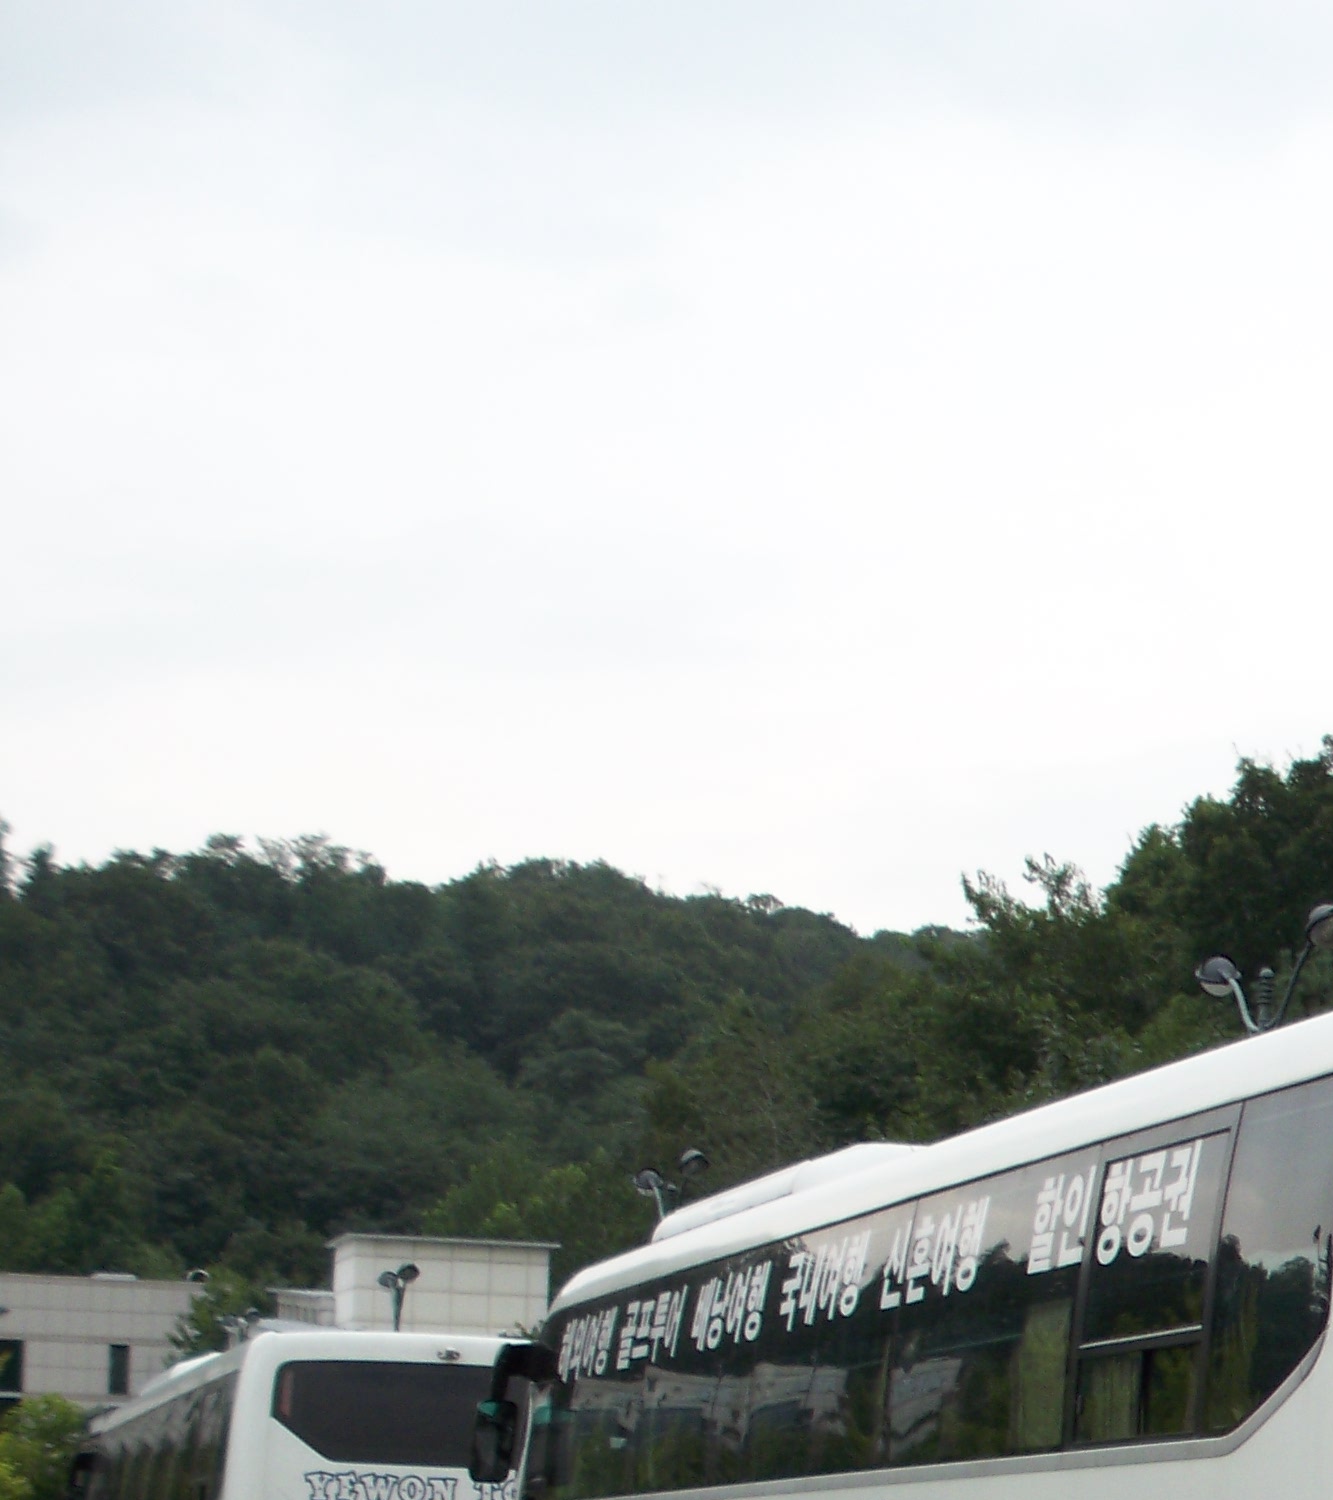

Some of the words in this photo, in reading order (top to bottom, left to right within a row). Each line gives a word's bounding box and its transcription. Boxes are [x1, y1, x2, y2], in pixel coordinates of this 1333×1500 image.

[616, 1284, 689, 1371] 골프투어
[691, 1260, 772, 1351] 배낭여행
[779, 1231, 871, 1332] 국내여행
[880, 1196, 990, 1310] 신혼여행
